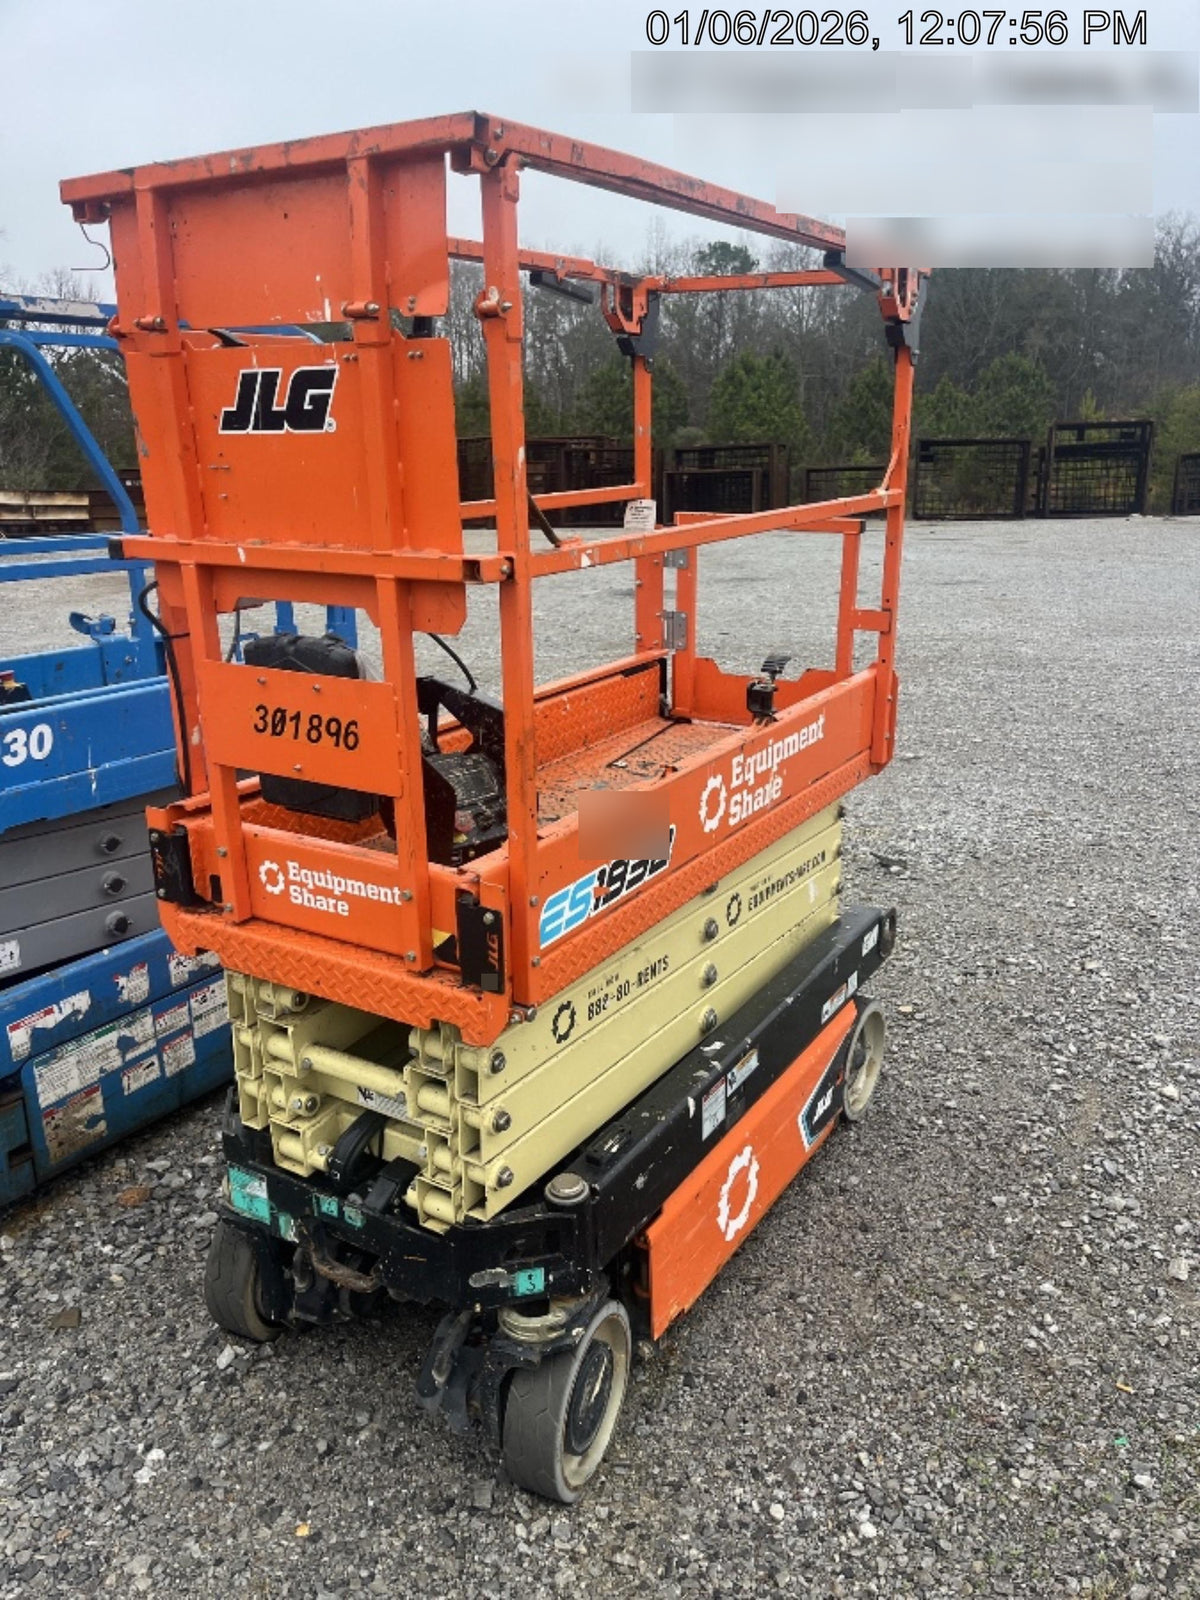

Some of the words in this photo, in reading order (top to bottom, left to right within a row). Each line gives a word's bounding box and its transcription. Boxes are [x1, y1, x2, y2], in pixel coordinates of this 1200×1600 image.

[219, 365, 339, 434] JLG
[254, 704, 360, 751] 301896
[730, 713, 826, 789] Equipment
[728, 774, 783, 827] Share
[286, 860, 402, 905] Equipment
[289, 884, 350, 916] Share
